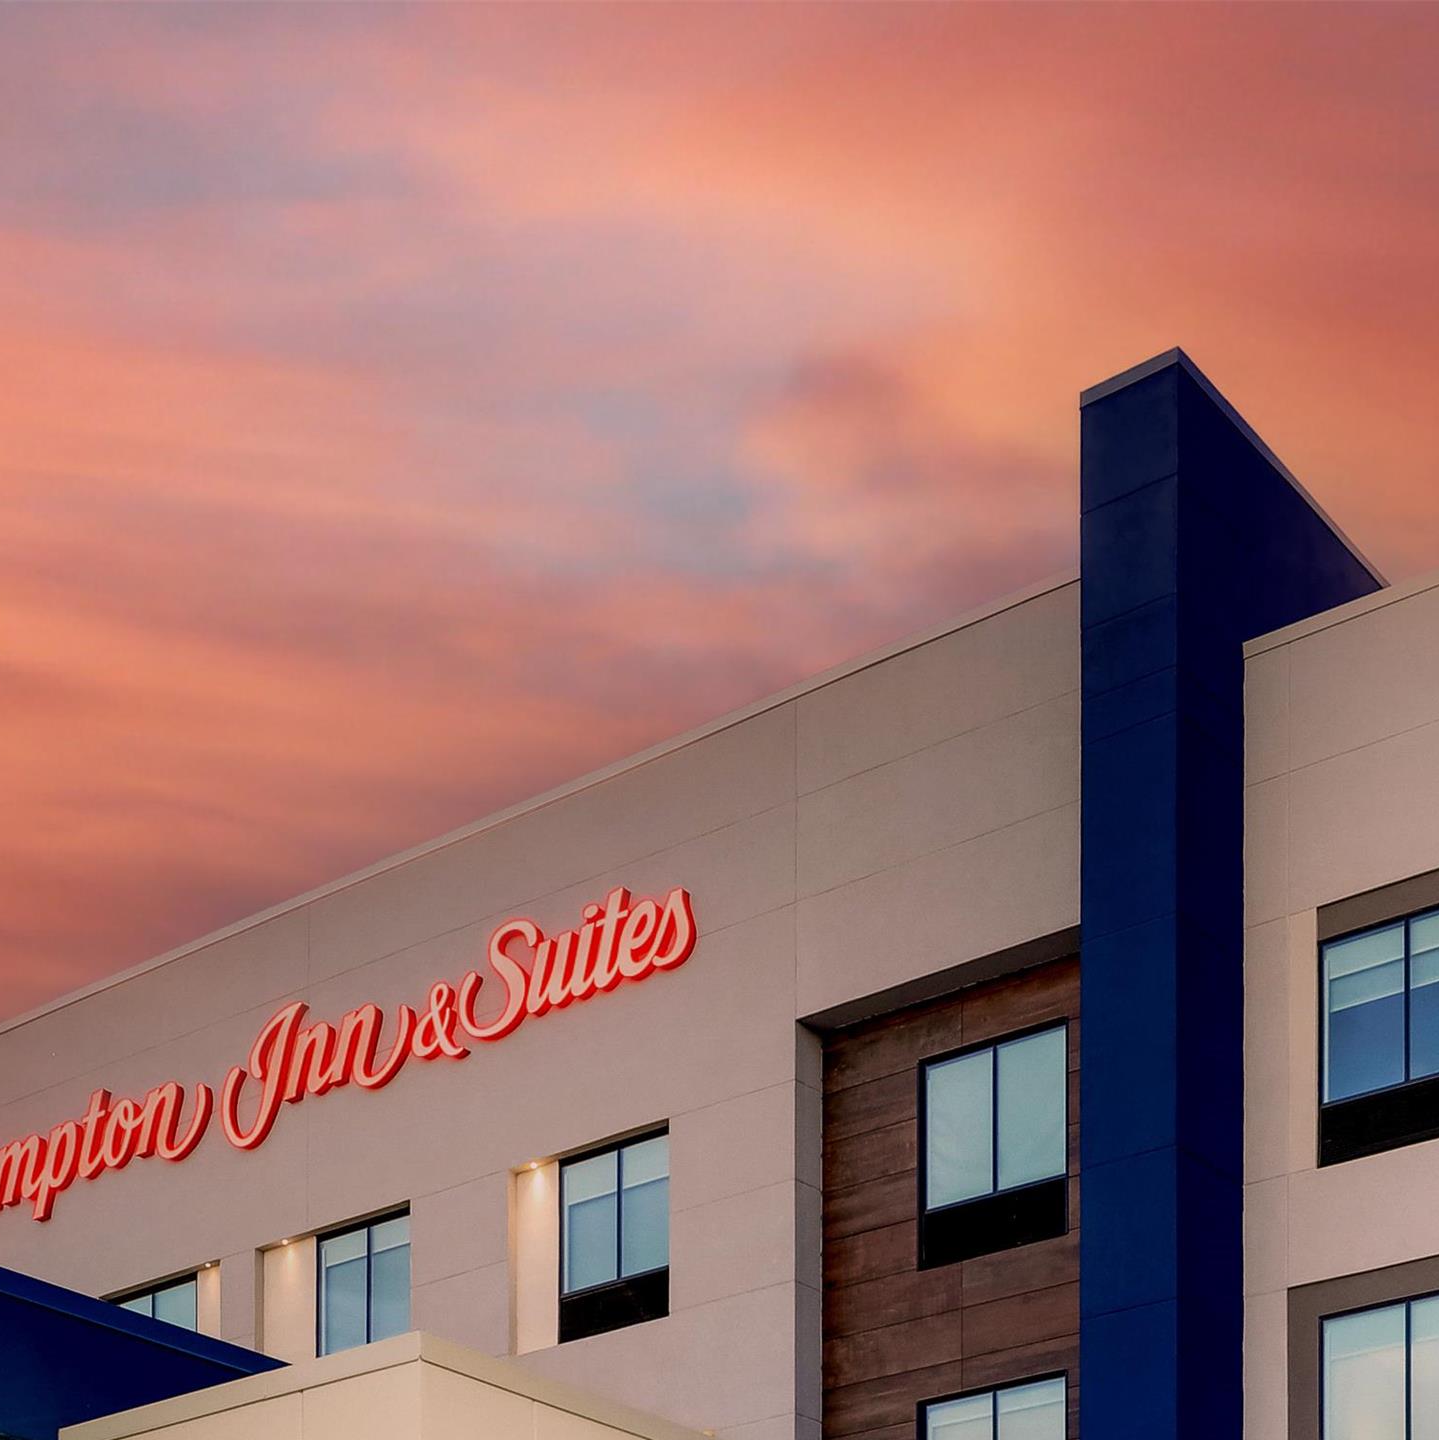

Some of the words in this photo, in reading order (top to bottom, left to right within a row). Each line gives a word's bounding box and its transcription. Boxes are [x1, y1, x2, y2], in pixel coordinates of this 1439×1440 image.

[222, 1003, 416, 1149] Inn
[411, 983, 471, 1062] &
[458, 887, 697, 1041] Suites
